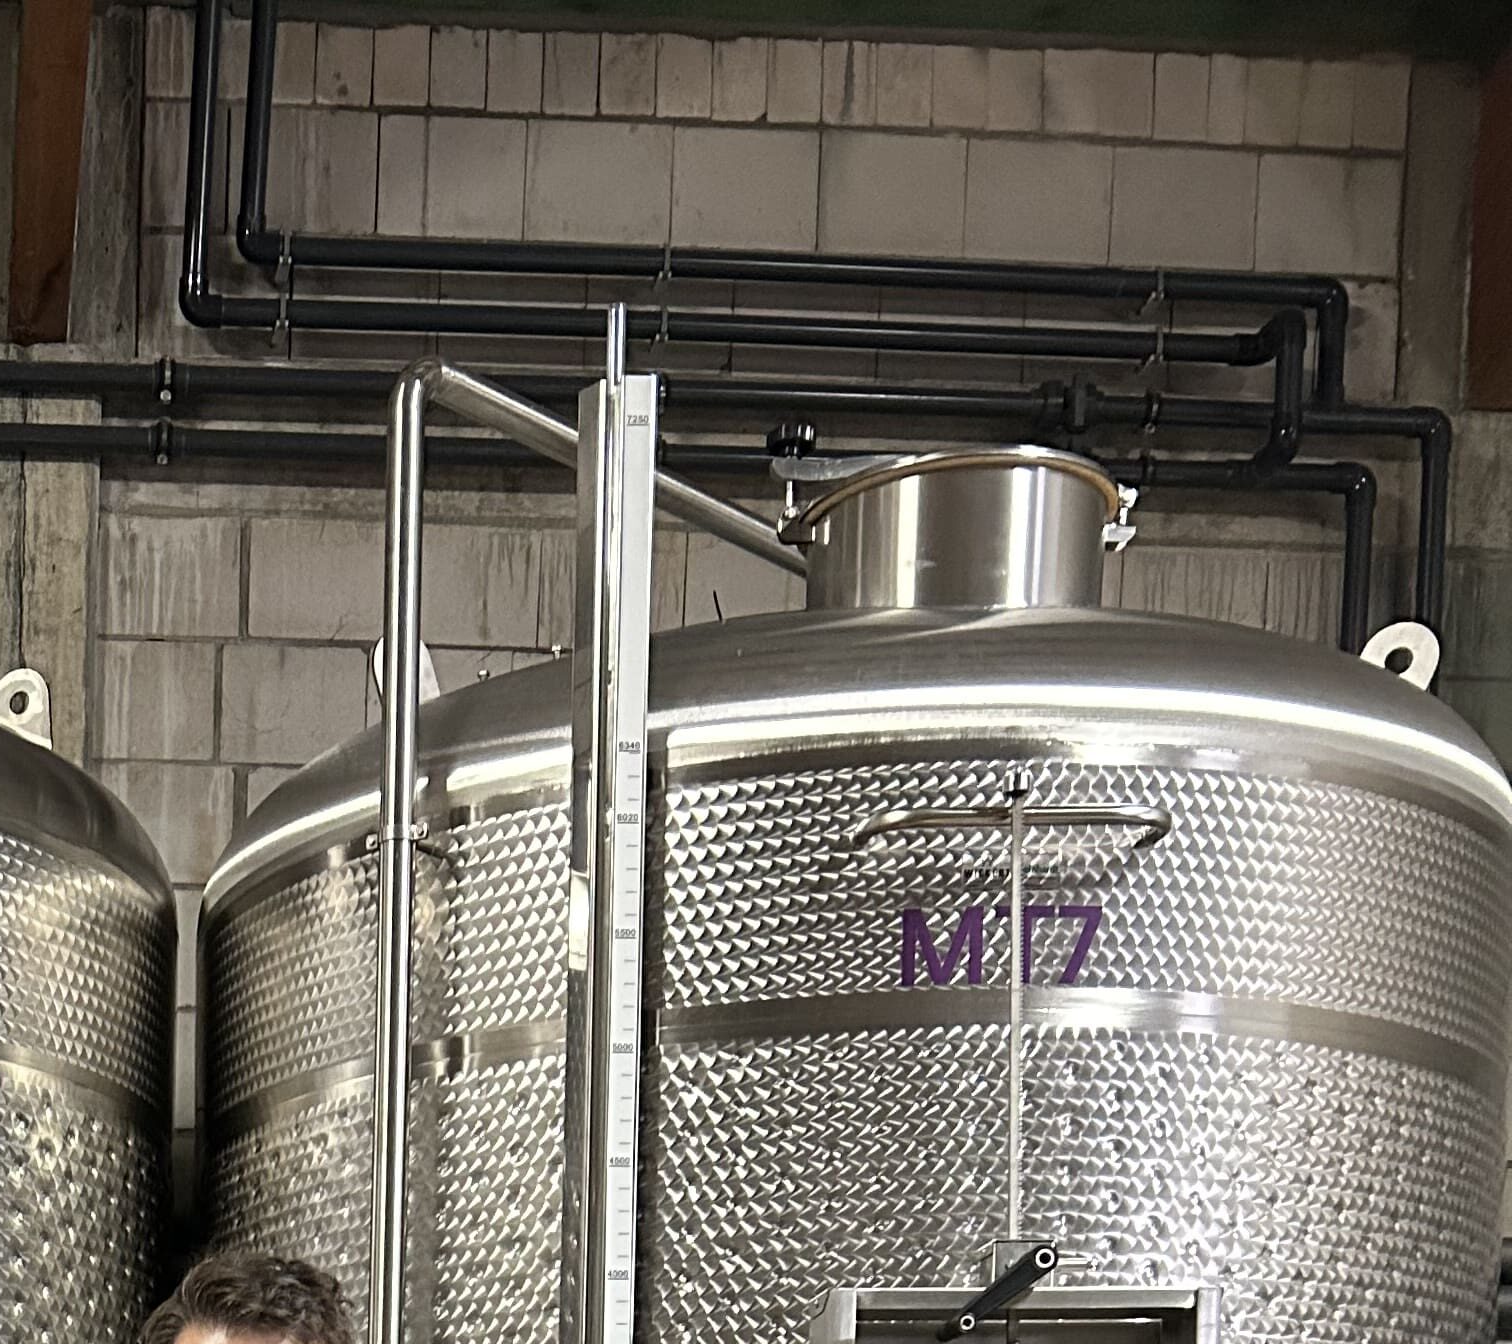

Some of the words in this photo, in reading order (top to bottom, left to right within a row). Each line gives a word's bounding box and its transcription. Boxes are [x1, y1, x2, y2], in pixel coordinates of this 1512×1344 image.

[614, 928, 637, 937] 5500
[902, 905, 1103, 986] MT7
[612, 1043, 634, 1052] 5000
[609, 1157, 631, 1165] 4500
[607, 1270, 629, 1278] 4000
